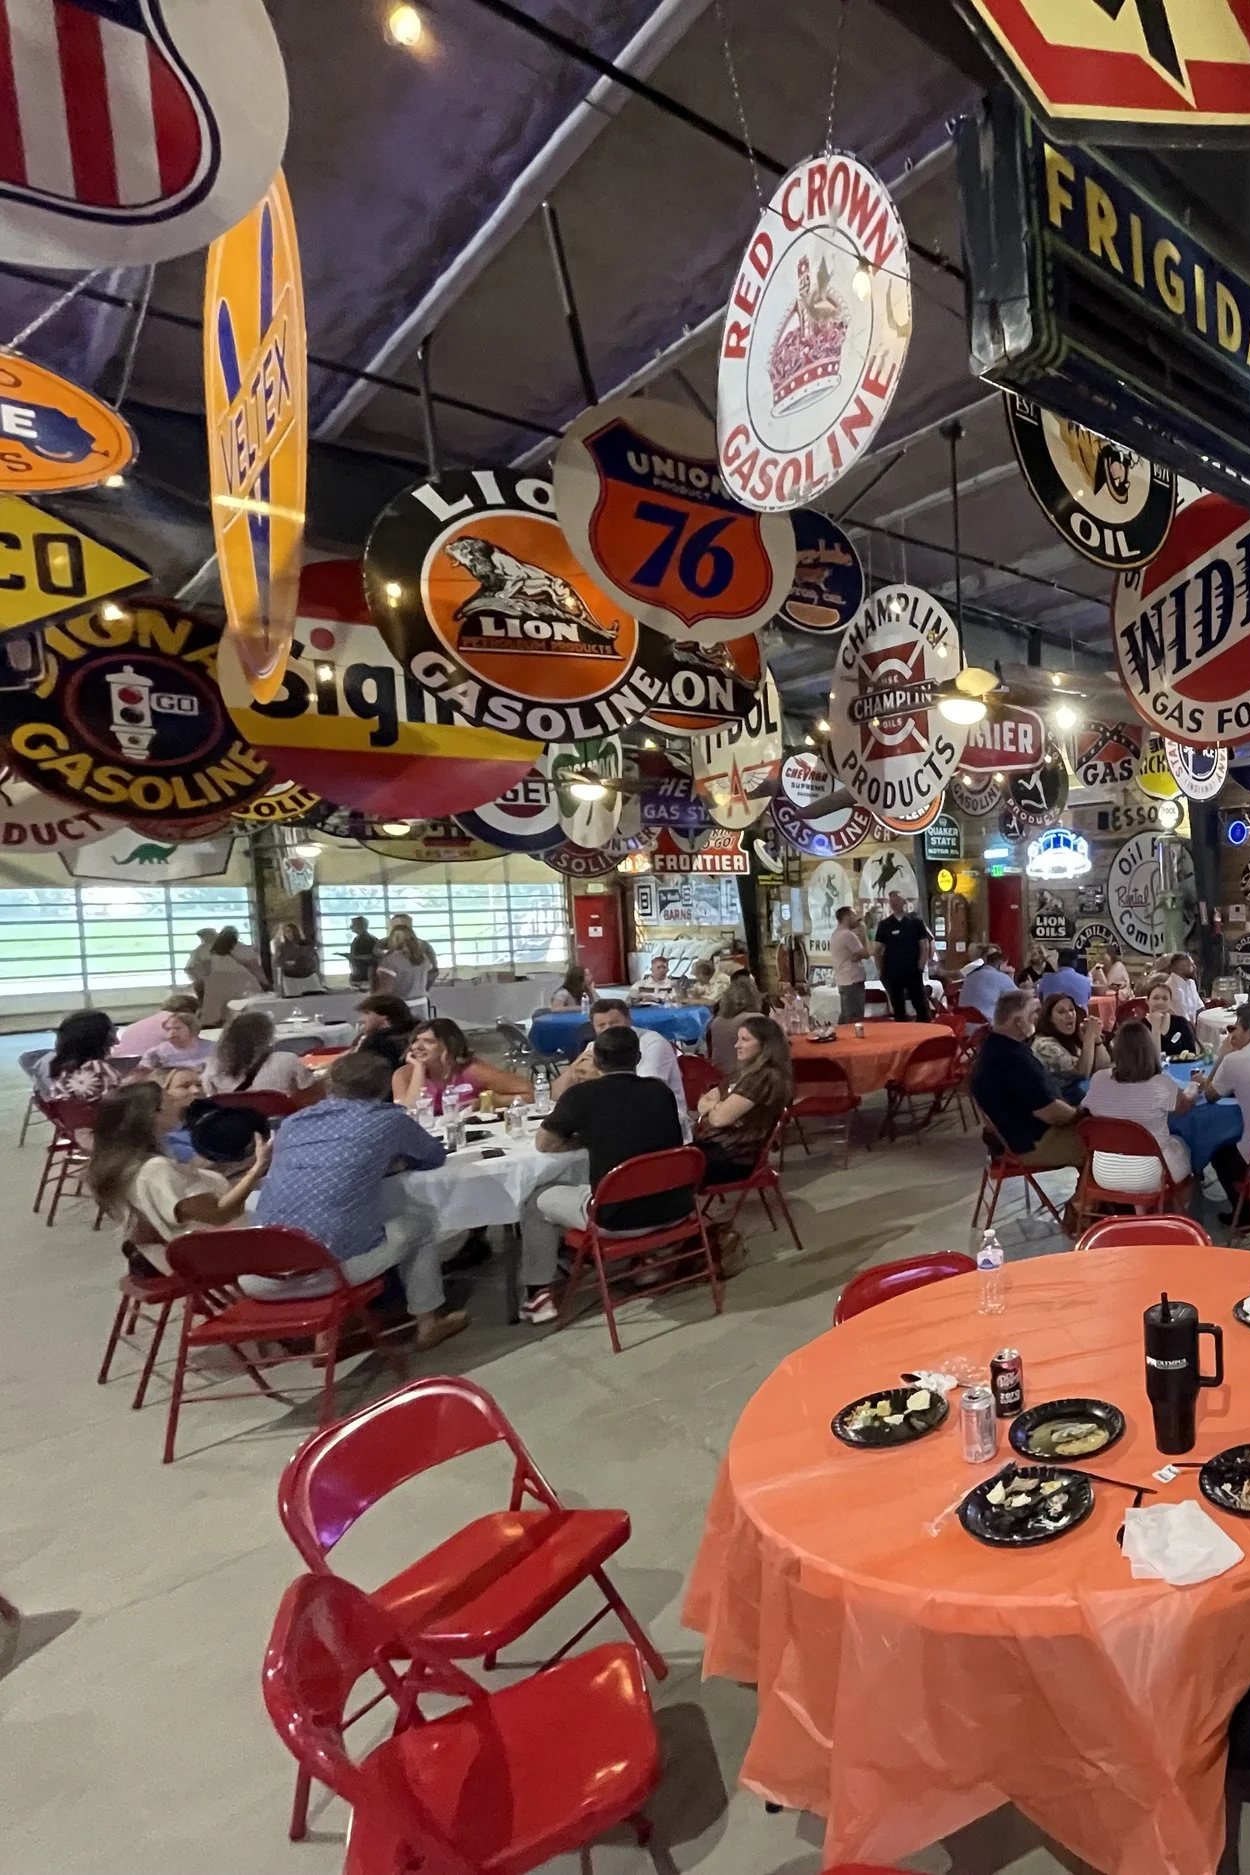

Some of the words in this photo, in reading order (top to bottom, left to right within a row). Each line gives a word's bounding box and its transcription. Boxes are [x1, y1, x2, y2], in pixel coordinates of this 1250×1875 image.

[723, 231, 774, 359] RED
[781, 162, 899, 274] CROWN
[721, 353, 897, 503] GASOLINE
[411, 470, 554, 522] LIO
[628, 500, 738, 599] 76
[1069, 511, 1141, 558] OIL
[479, 615, 581, 642] LION
[841, 592, 949, 669] CHAMPLIN
[35, 607, 221, 699] IGNA
[155, 694, 196, 713] GO
[410, 650, 663, 740] GASOLINE
[657, 669, 735, 712] ON
[853, 684, 933, 720] CHAMPLIN
[1151, 688, 1205, 734] GAS
[968, 719, 1034, 754] MIER
[11, 721, 268, 811] GASOLINE
[785, 767, 828, 782] CHEVRON
[841, 734, 956, 810] PRODUCTS
[1083, 758, 1134, 786] GAS
[790, 781, 826, 792] SUPREME
[953, 783, 1002, 812] GASOLIN
[644, 804, 681, 820] GAS
[778, 805, 869, 852] GASOLINE
[927, 827, 959, 836] QUAKER
[930, 837, 957, 846] STATE
[654, 854, 745, 871] FRONTIER
[1118, 841, 1143, 876] Oil
[1035, 926, 1067, 937] OILS
[1036, 916, 1066, 926] LION
